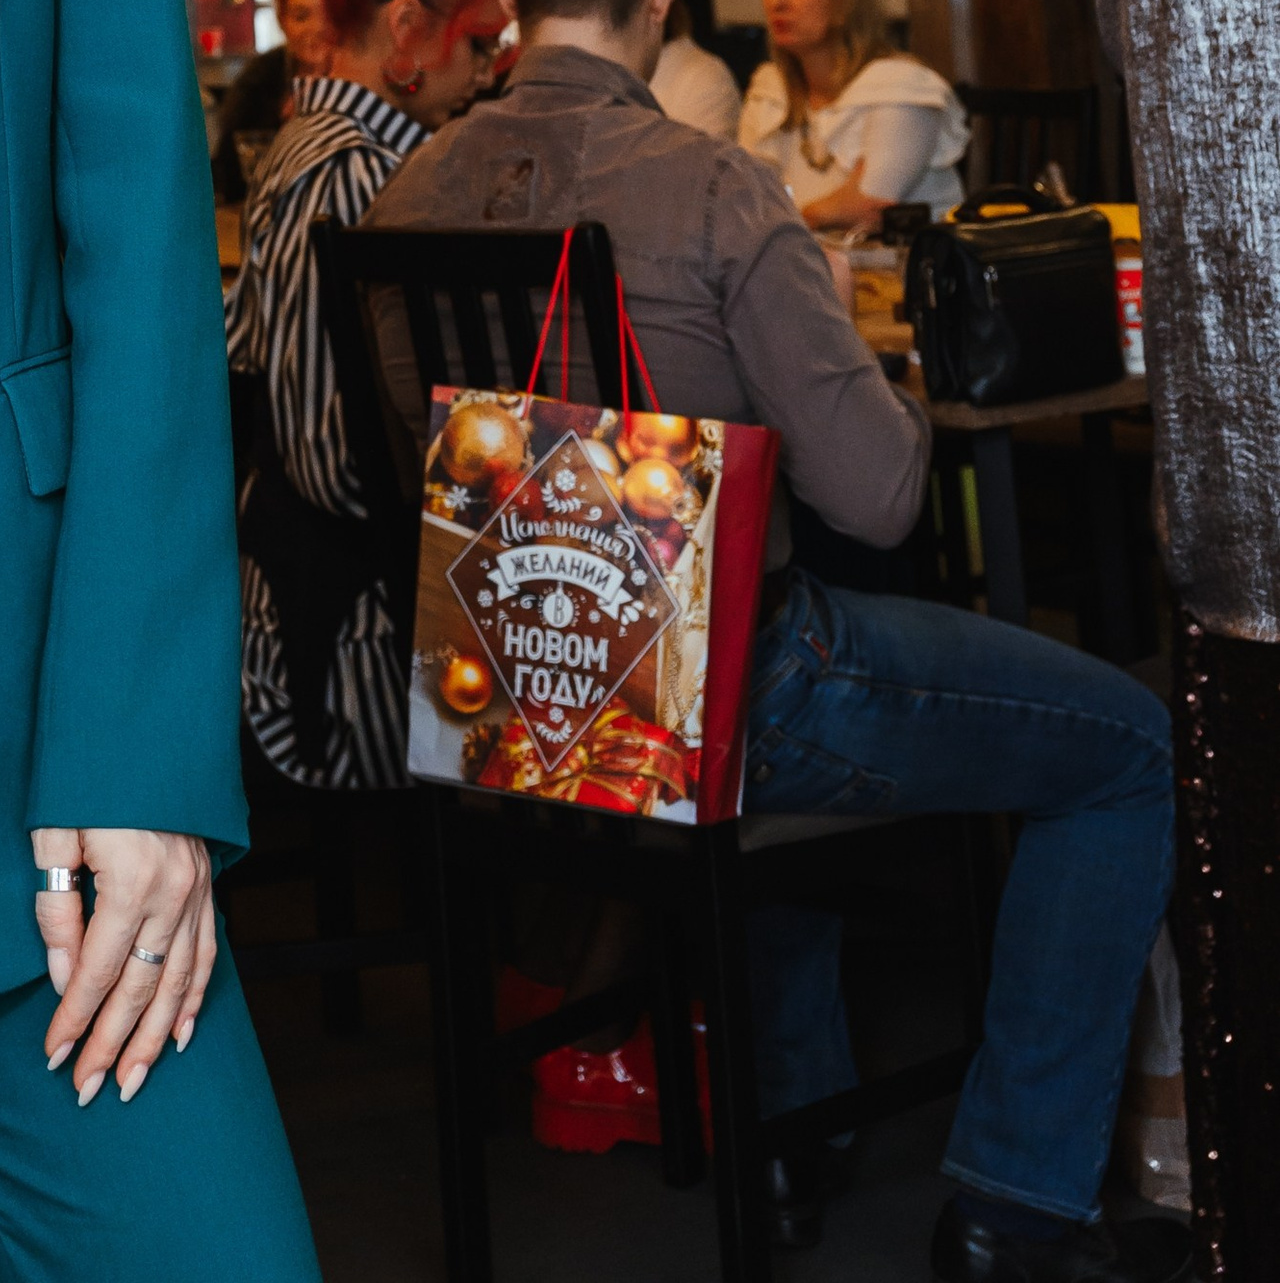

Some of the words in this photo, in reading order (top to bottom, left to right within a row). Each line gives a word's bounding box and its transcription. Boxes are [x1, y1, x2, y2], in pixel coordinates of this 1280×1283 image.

[510, 552, 612, 590] ЖЕЛАНИЙ
[552, 594, 565, 623] В
[504, 622, 609, 673] НОВОМ
[515, 663, 595, 709] ГОДУ
